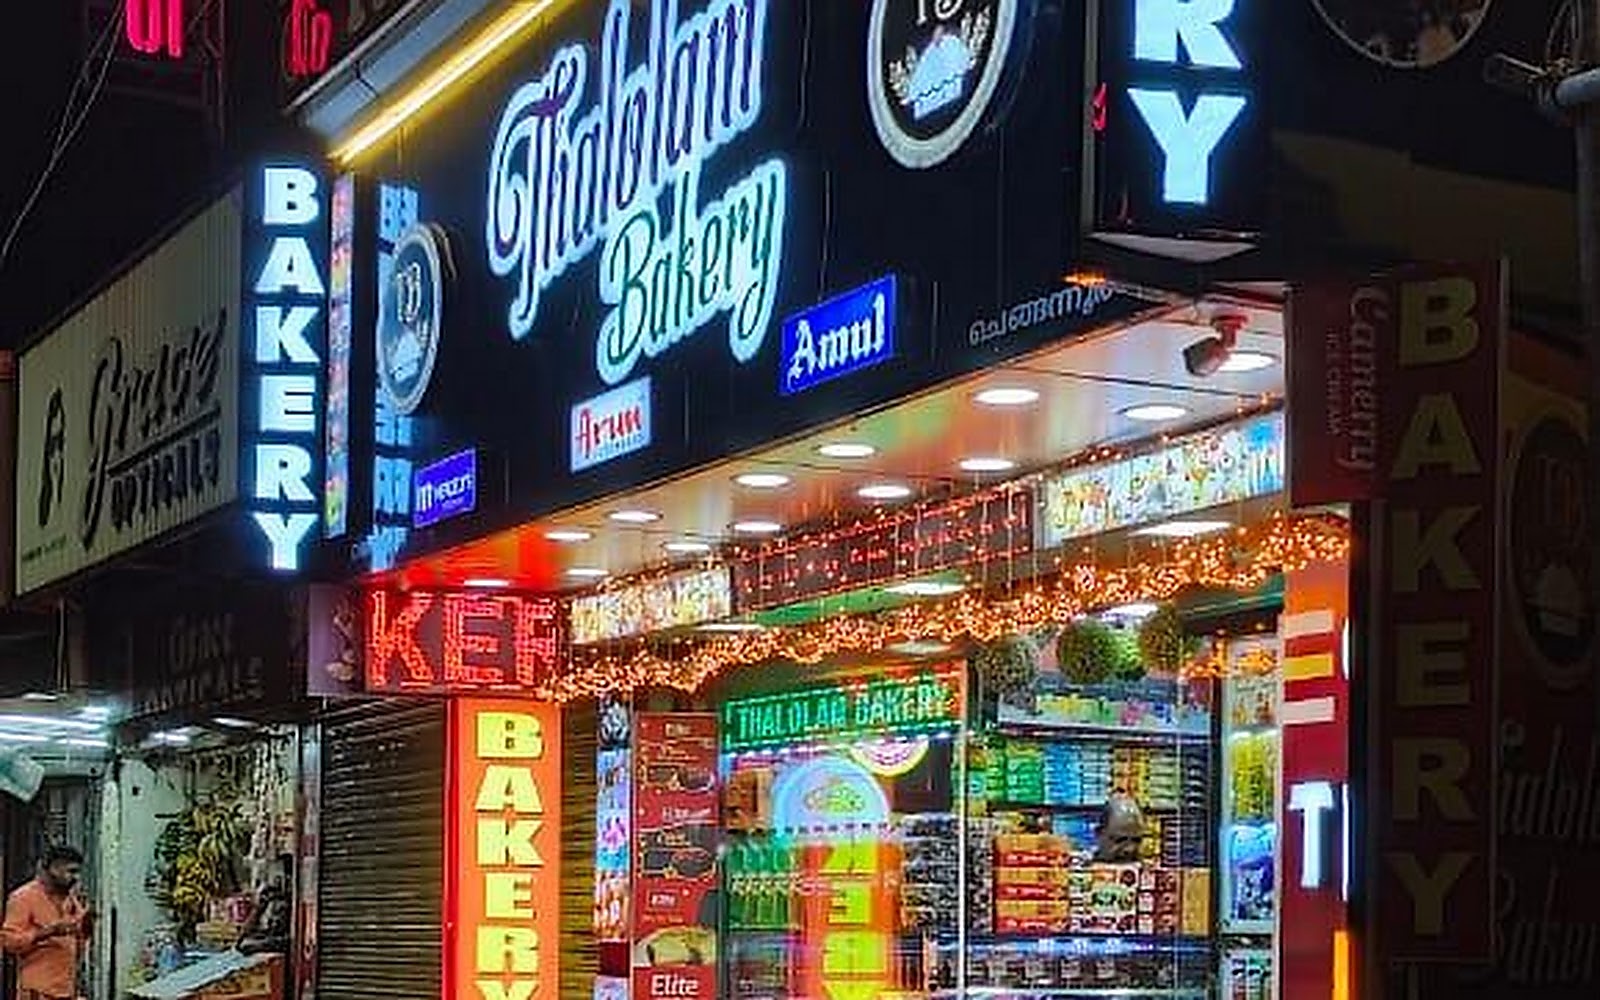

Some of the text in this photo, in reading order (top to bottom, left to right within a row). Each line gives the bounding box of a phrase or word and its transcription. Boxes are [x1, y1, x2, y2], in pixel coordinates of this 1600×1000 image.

[252, 166, 324, 571] BAKERY
[597, 158, 786, 385] Bakery
[787, 292, 887, 391] Amul
[1385, 277, 1481, 937] BAKERY
[650, 973, 700, 997] Elite
